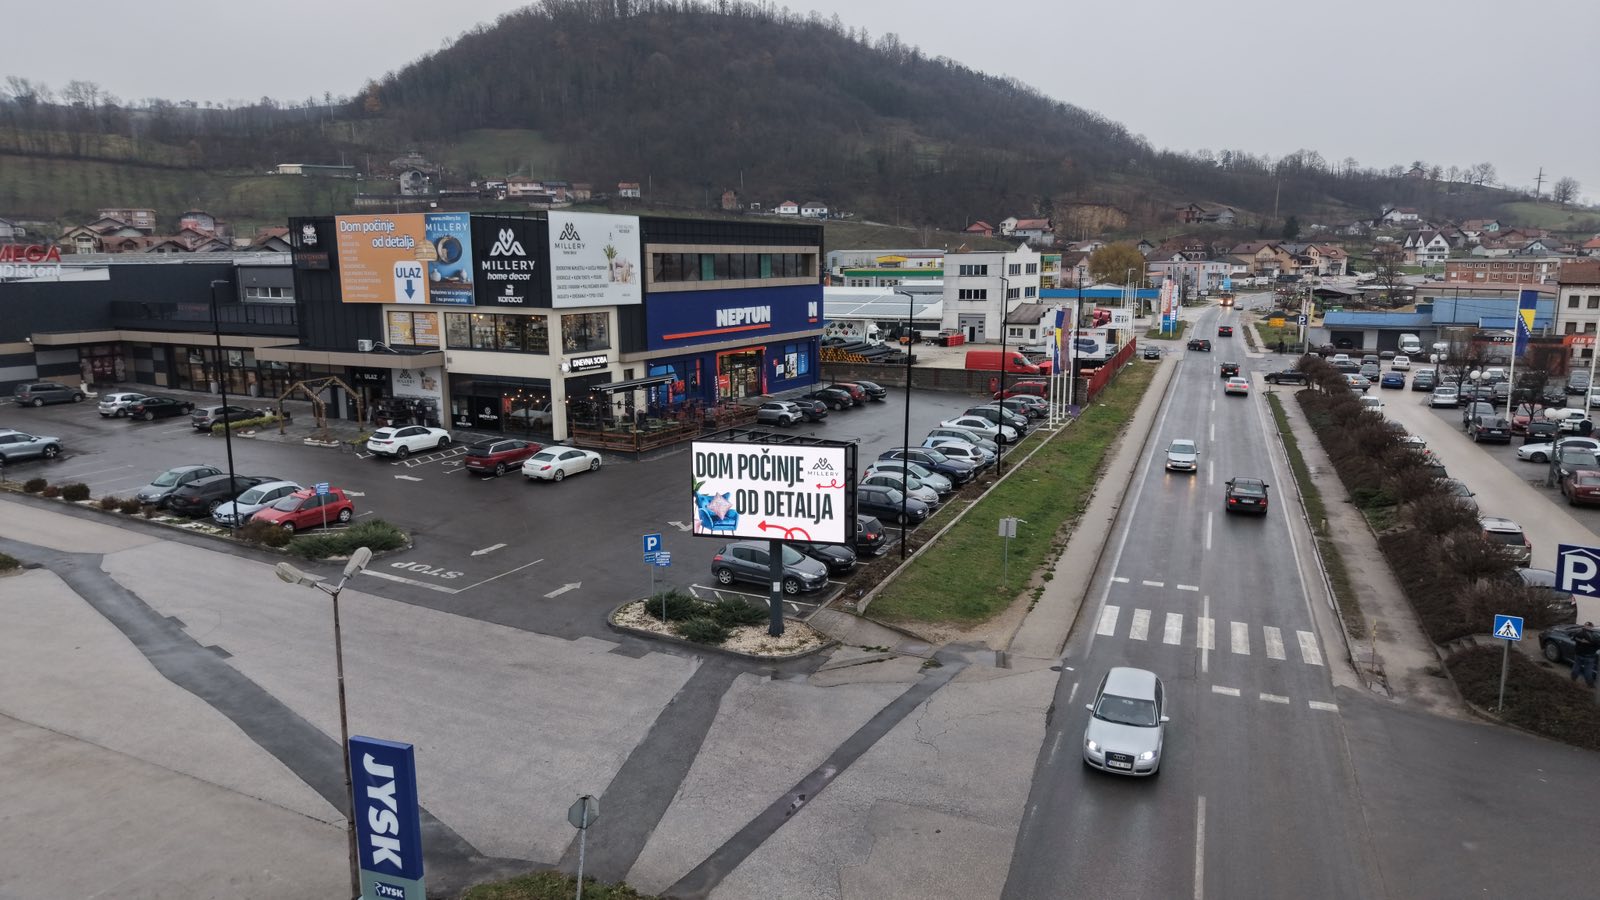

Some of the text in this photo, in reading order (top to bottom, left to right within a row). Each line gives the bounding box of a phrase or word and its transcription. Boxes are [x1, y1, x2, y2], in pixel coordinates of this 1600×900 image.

[340, 218, 395, 233] Dom počinje
[426, 223, 467, 231] MILLERY
[372, 234, 415, 250] od detalja
[396, 267, 421, 278] ULAZ
[482, 260, 535, 270] MILLERY
[487, 272, 531, 280] home decor
[716, 306, 771, 327] NEPTUN
[808, 302, 818, 317] N
[572, 356, 608, 367] DNEVNA SOBA
[695, 448, 804, 488] DOM POČINJE
[735, 488, 834, 525] OD DETALJA
[648, 537, 658, 550] P
[390, 562, 464, 578] STOP
[1562, 554, 1598, 592] P
[363, 752, 403, 870] JYSK
[382, 886, 404, 898] JYSK
